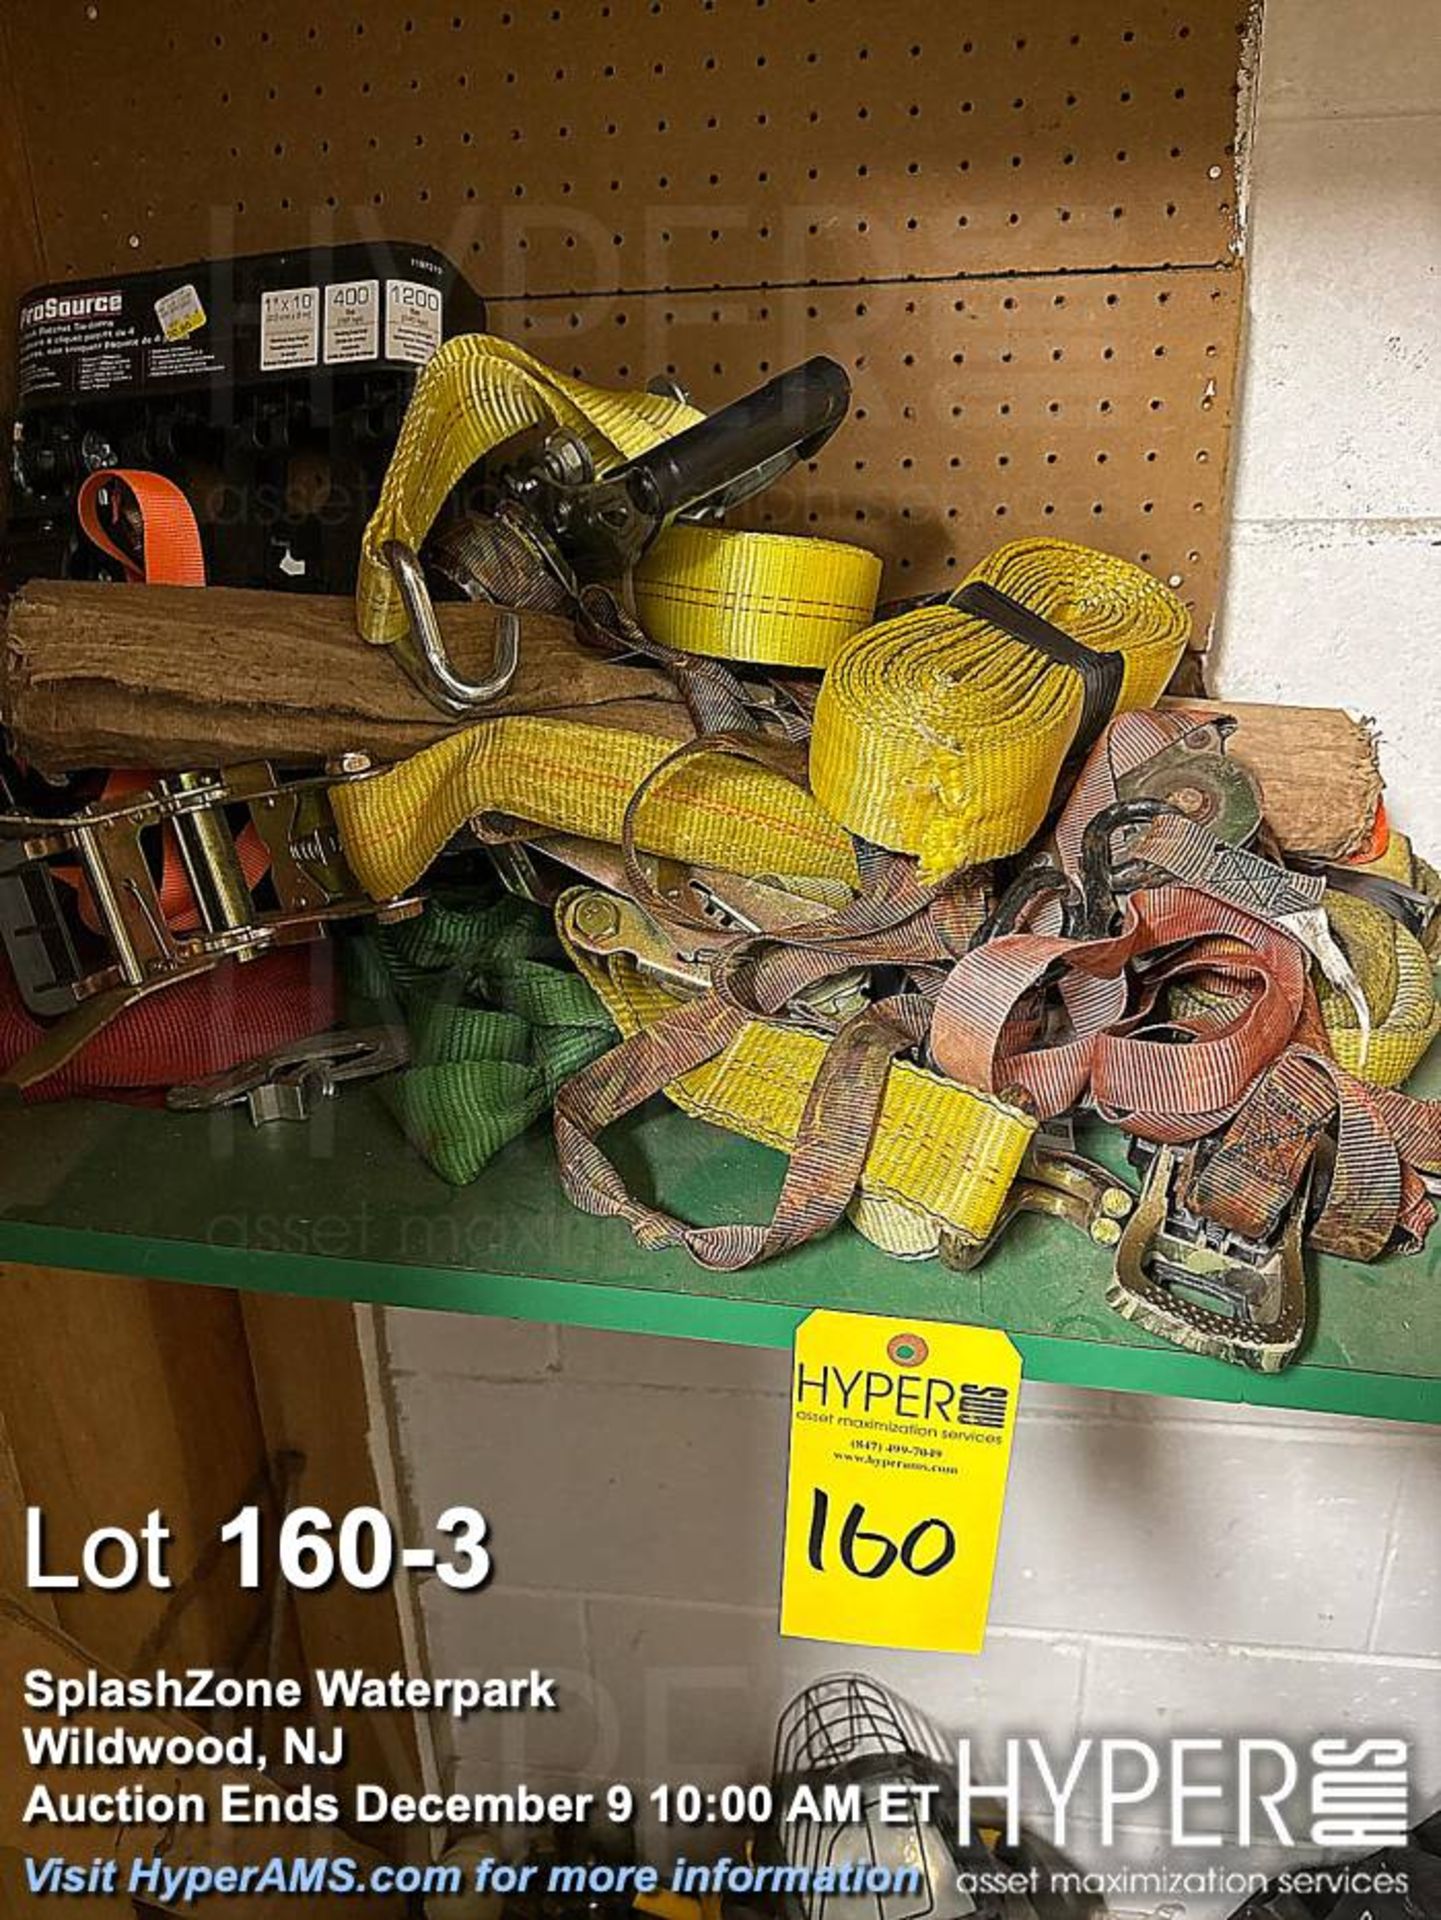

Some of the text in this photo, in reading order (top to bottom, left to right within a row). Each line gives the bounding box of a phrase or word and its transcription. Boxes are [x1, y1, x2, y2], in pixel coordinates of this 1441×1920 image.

[333, 286, 369, 307] 400
[391, 284, 439, 312] 1200
[798, 1361, 956, 1423] HYPER
[796, 1410, 1003, 1445] asset maximization services
[850, 1439, 882, 1453] (847)
[808, 1487, 957, 1580] 160
